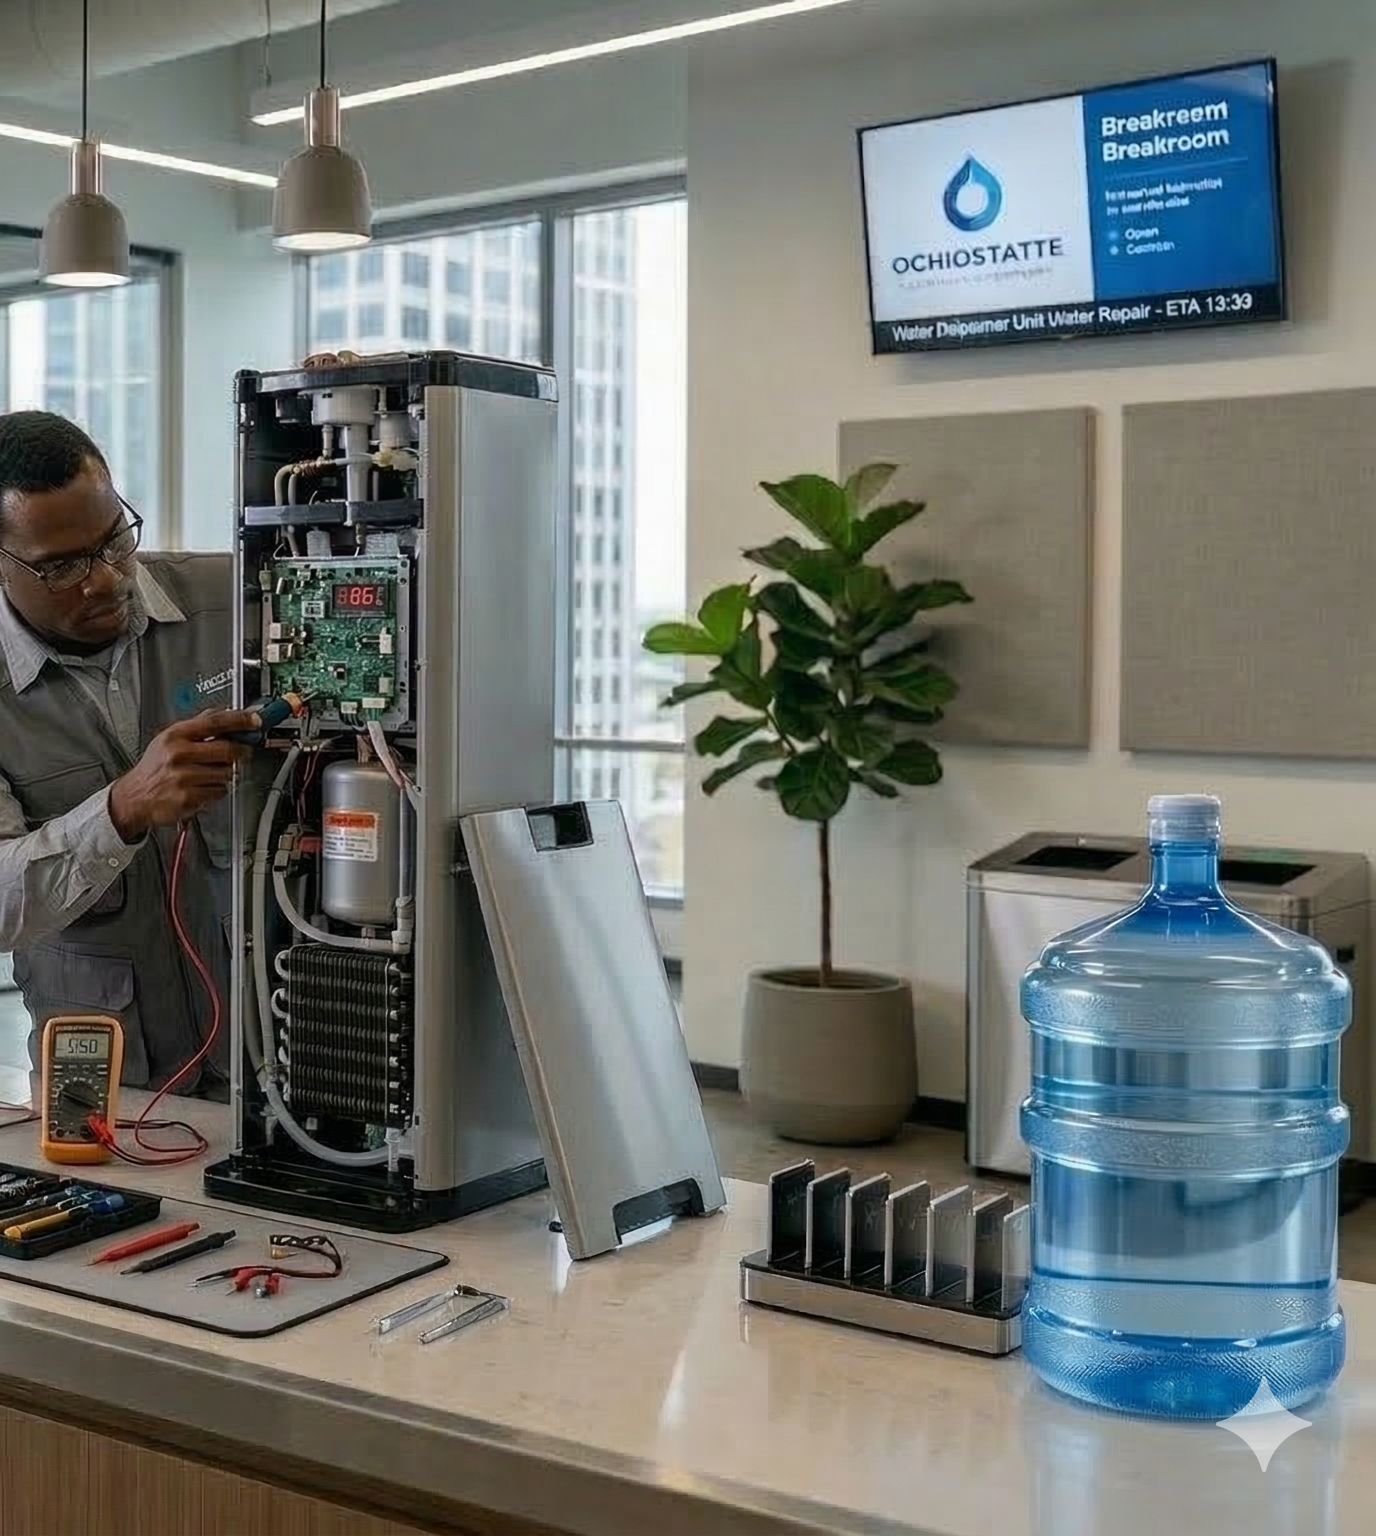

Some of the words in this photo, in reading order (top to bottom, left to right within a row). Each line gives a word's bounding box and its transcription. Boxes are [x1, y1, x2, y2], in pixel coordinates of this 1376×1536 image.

[1102, 129, 1230, 162] Breakroom
[892, 238, 1064, 274] OCHIOSTATTE
[1012, 312, 1045, 330] Unit
[1098, 303, 1151, 324] Repair
[1166, 298, 1201, 317] ETA
